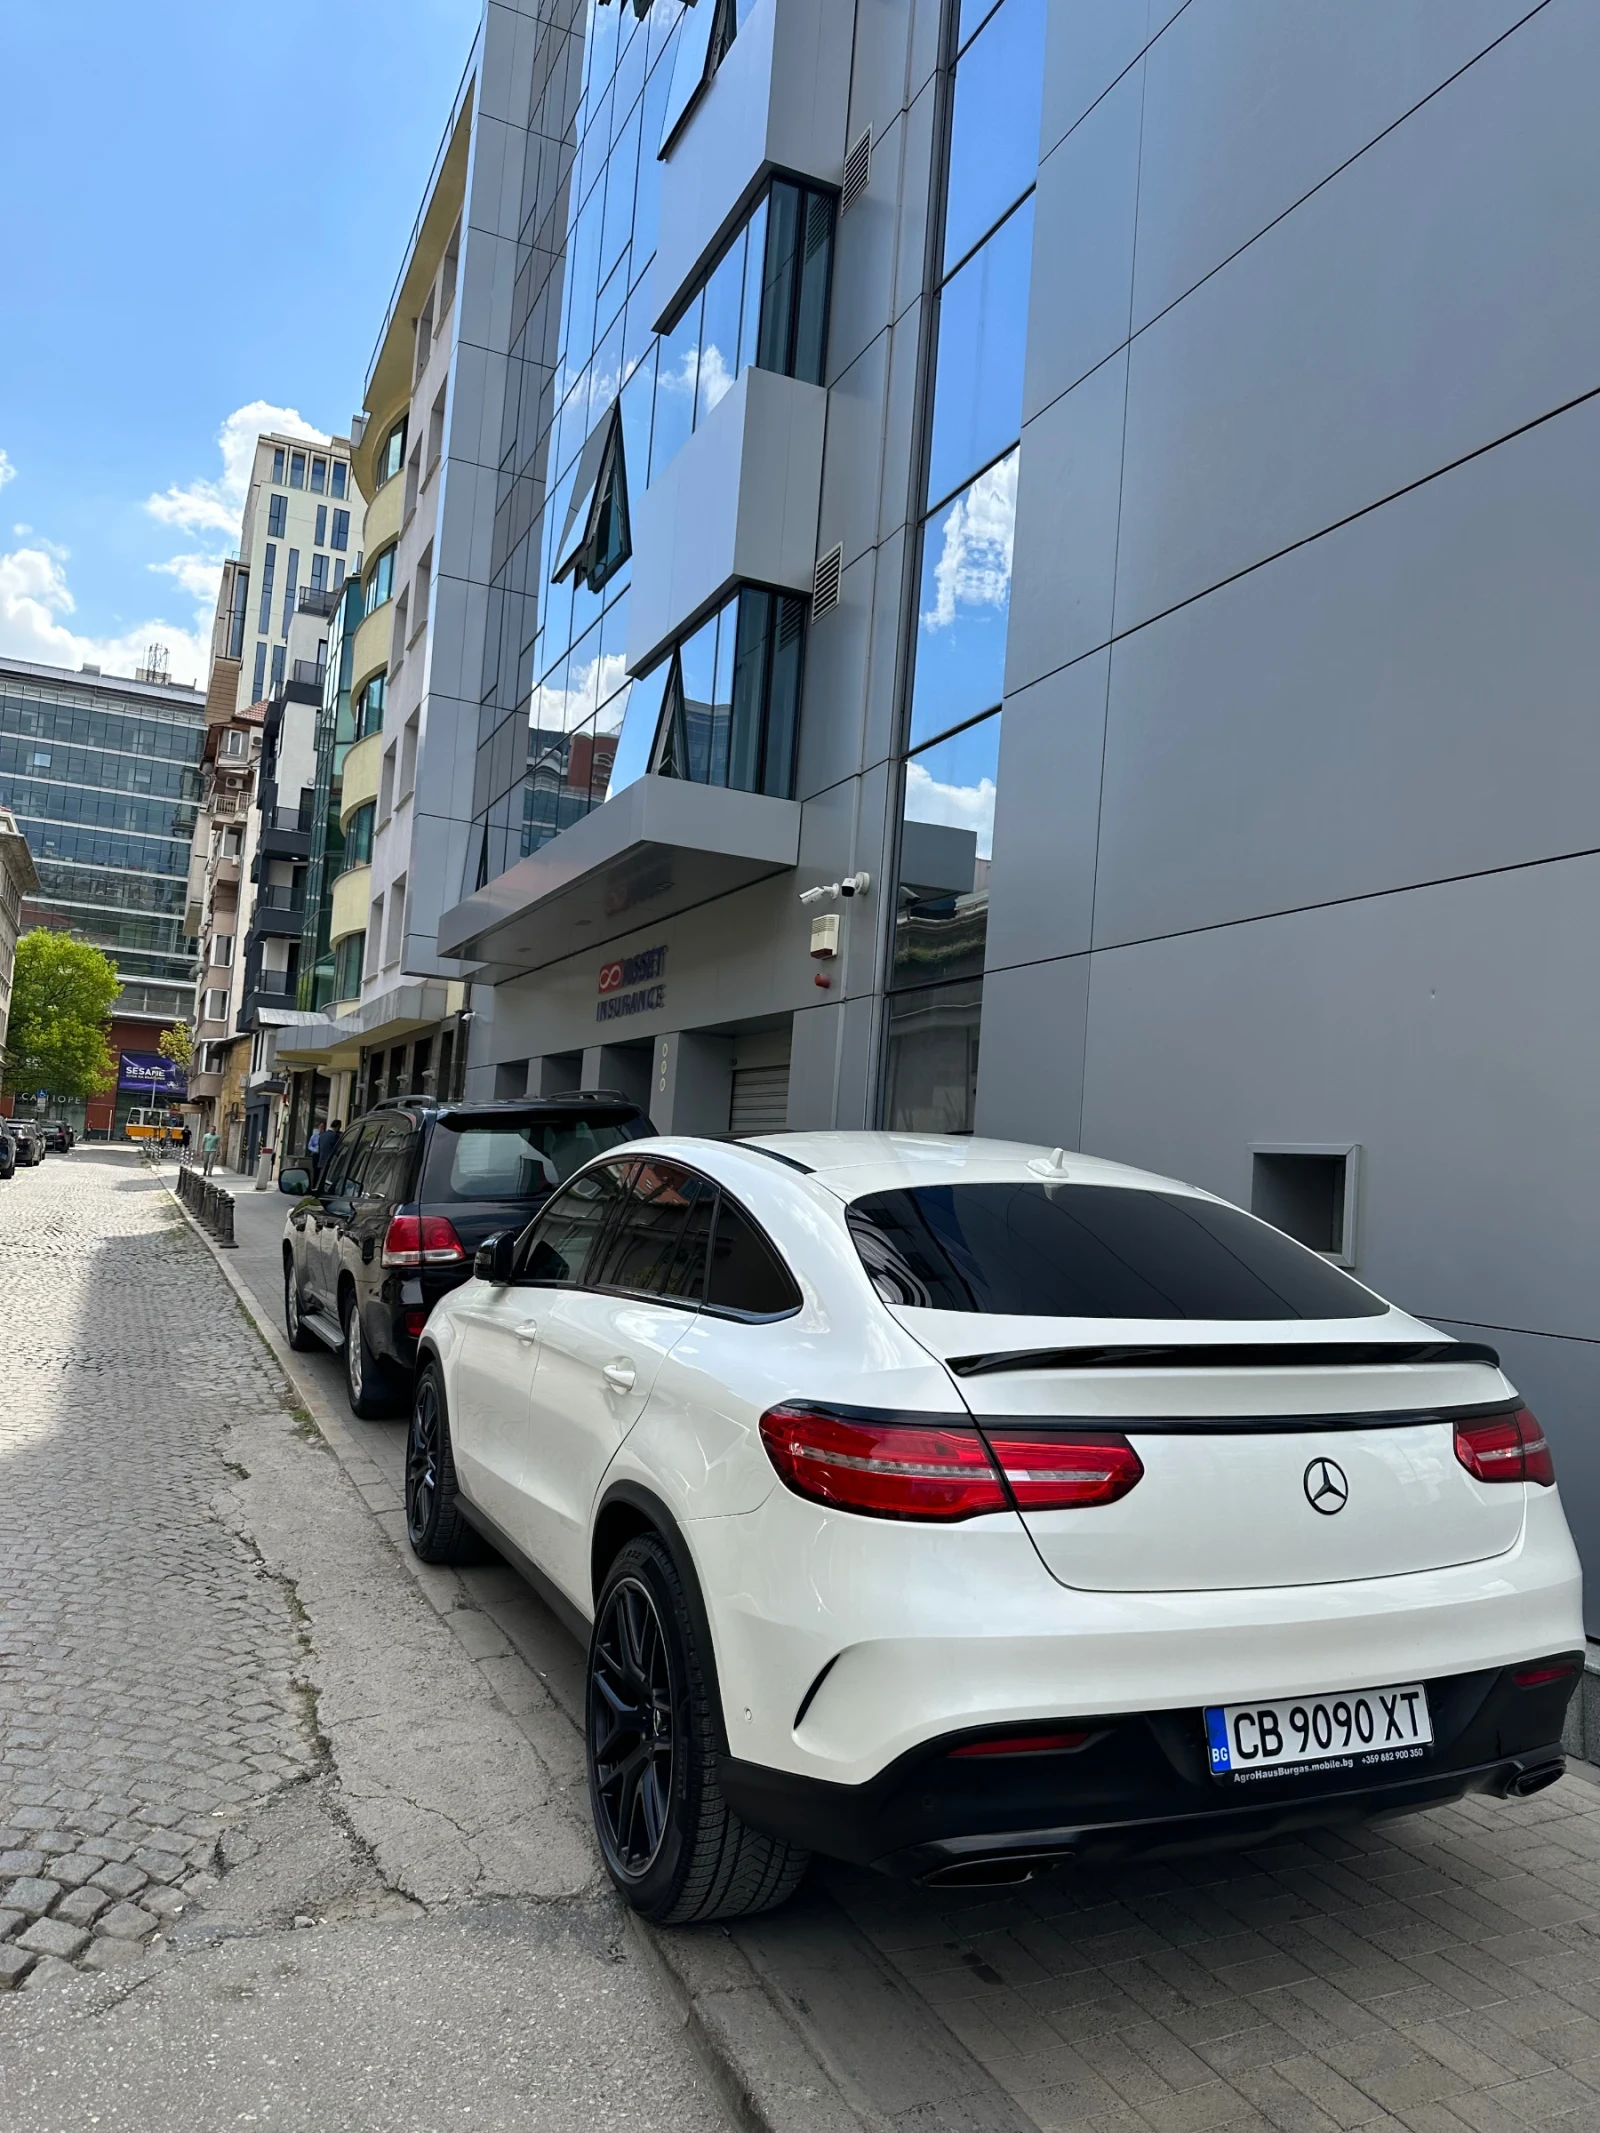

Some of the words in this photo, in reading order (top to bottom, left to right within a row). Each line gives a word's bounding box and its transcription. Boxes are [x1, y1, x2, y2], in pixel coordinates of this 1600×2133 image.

[622, 945, 669, 985] ASSET
[596, 984, 666, 1022] INSURANCE
[1234, 1710, 1283, 1760] CB
[1289, 1698, 1374, 1753] 9090
[1379, 1691, 1419, 1741] XT
[1211, 1747, 1228, 1763] BG
[1233, 1758, 1354, 1783] AgroHausBurgas.mobile.bg
[1361, 1754, 1380, 1765] +359
[1381, 1751, 1395, 1762] 882
[1396, 1749, 1409, 1760] 900
[1410, 1747, 1424, 1758] 350
